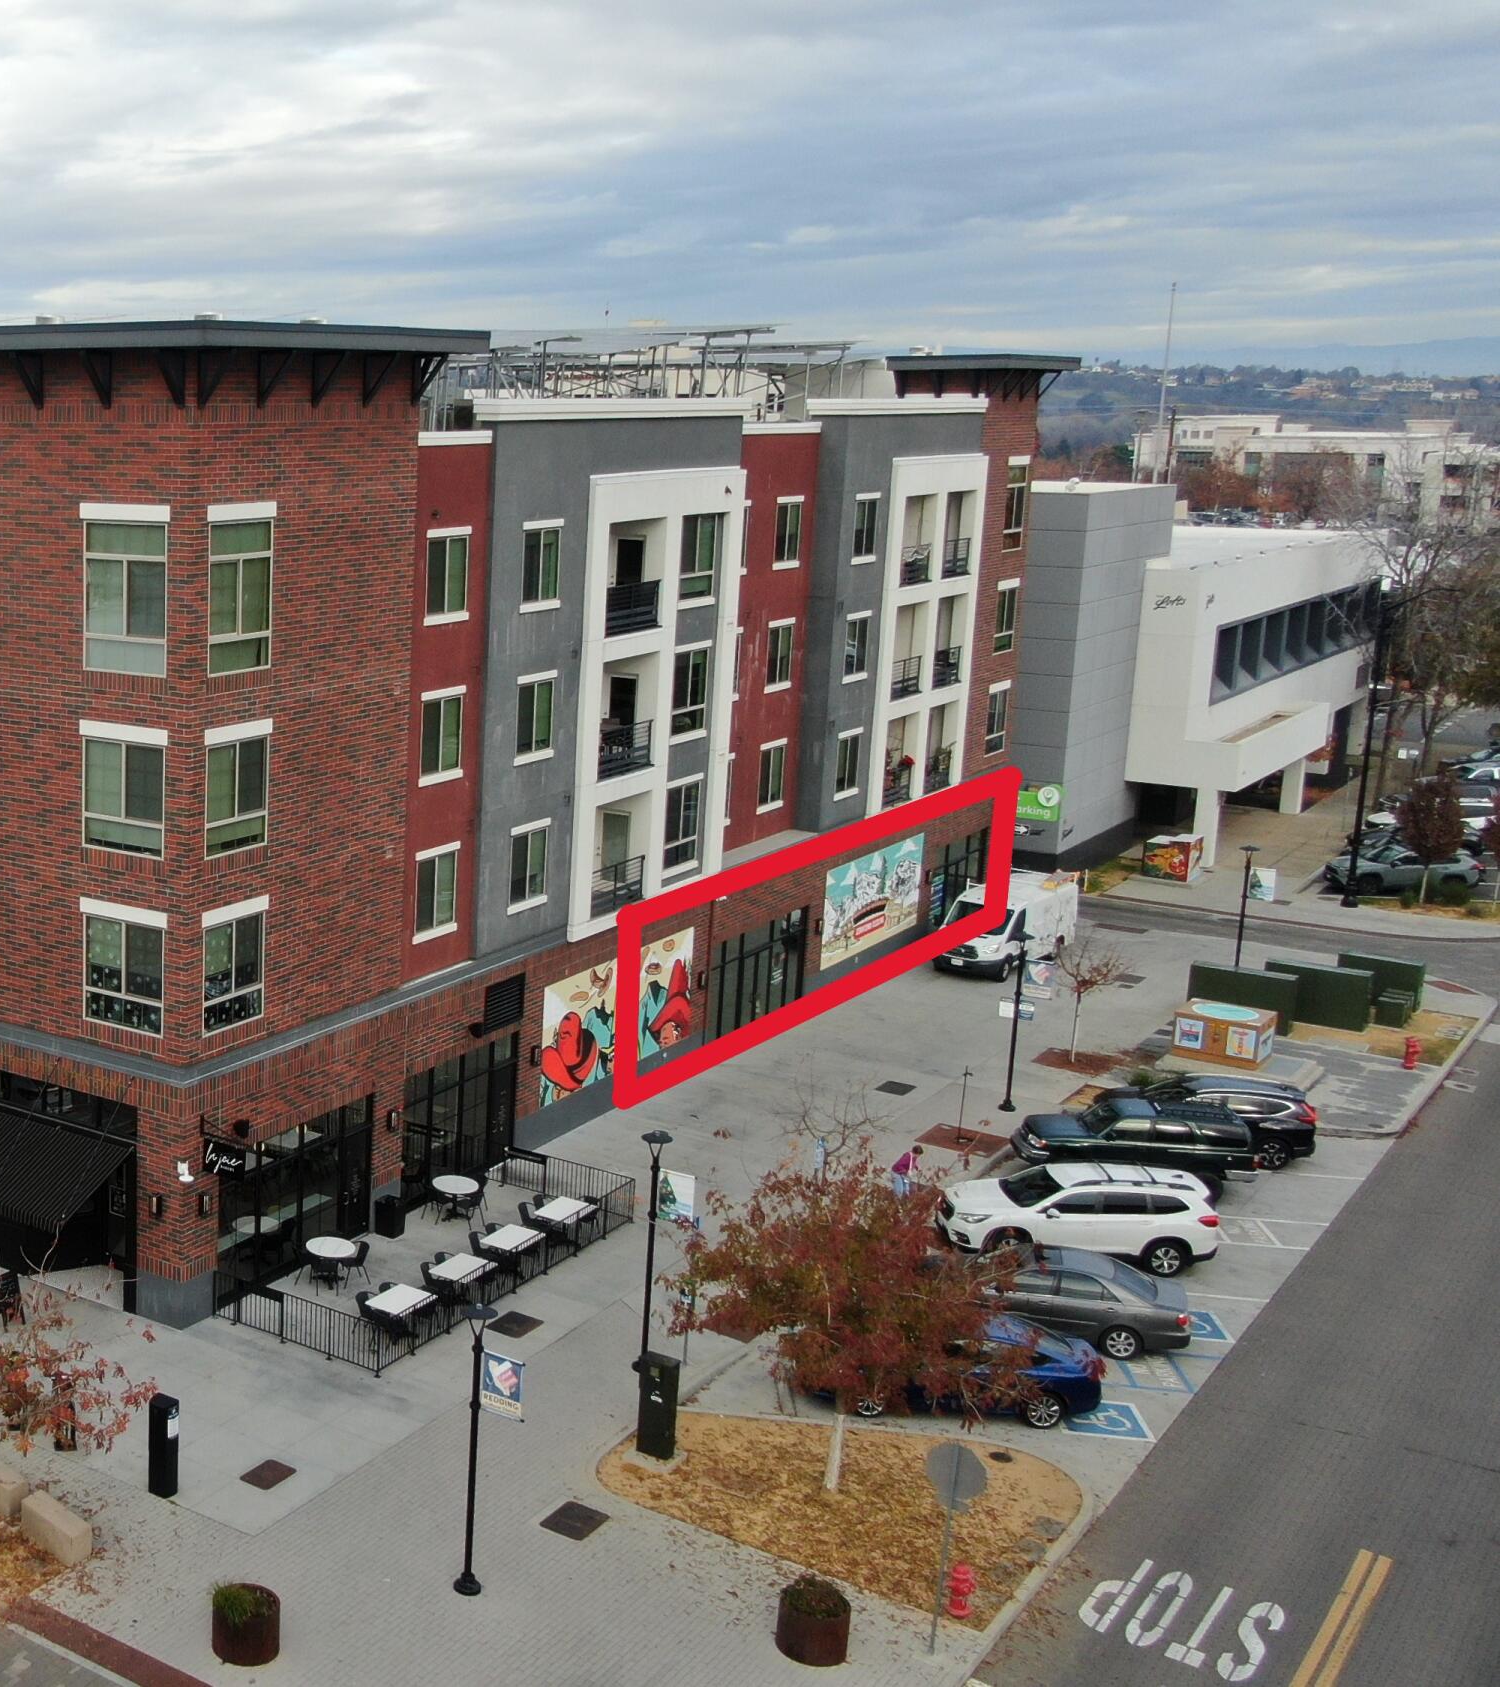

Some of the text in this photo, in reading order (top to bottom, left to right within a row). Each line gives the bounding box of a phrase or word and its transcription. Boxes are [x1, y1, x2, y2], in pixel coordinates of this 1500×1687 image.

[1016, 805, 1051, 819] arking
[483, 1393, 519, 1410] REDDING
[1077, 1558, 1285, 1682] STOP
